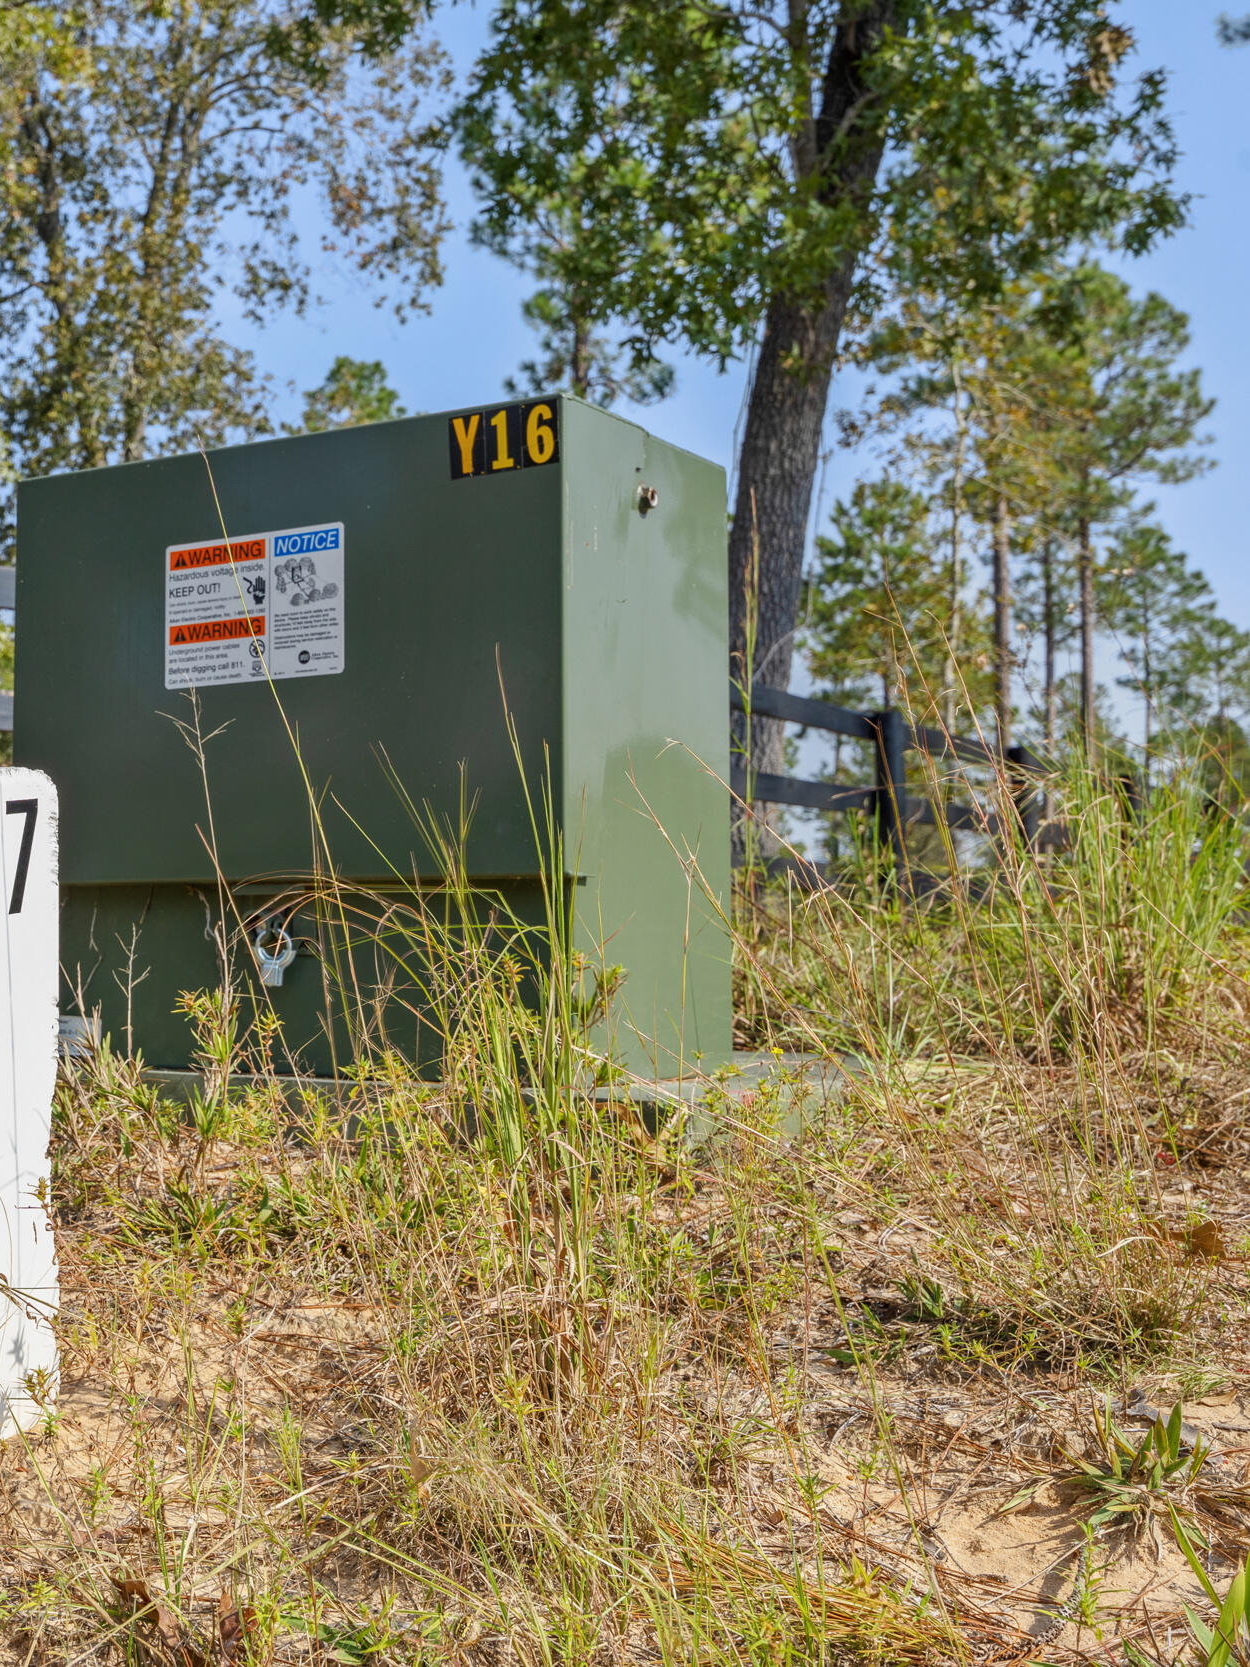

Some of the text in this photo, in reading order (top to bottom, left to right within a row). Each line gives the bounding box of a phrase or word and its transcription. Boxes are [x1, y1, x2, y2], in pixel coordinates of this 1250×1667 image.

[452, 404, 555, 474] Y16
[276, 531, 337, 554] NOTICE
[188, 542, 262, 566] WARNING
[169, 570, 209, 581] Hazardous
[210, 566, 238, 577] voltage
[169, 582, 221, 599] KEEP OUT!
[187, 619, 262, 641] WARNING
[169, 646, 203, 656] Underground
[204, 645, 221, 653] power
[168, 666, 190, 675] Before
[191, 664, 217, 674] digging
[218, 662, 229, 670] call
